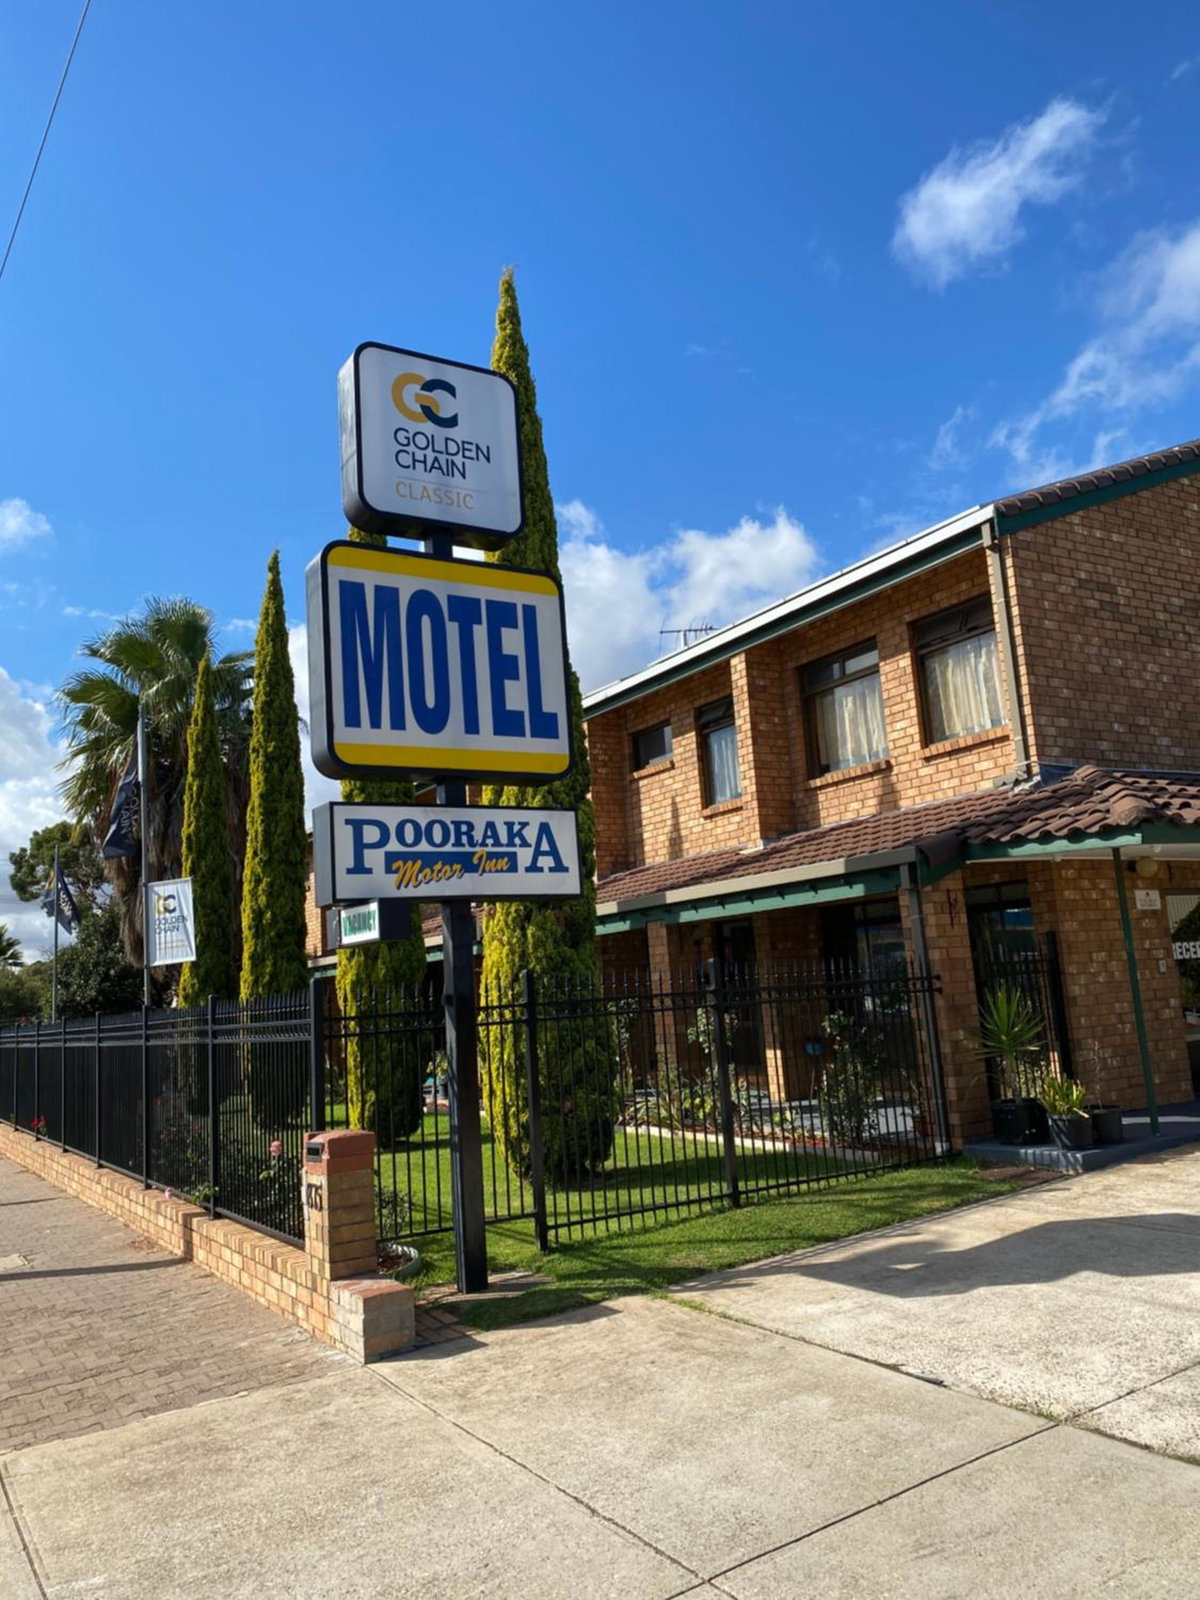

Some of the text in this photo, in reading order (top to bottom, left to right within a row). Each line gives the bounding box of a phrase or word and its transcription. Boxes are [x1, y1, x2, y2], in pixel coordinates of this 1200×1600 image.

[393, 427, 491, 464] GOLDEN
[395, 449, 467, 480] CHAIN
[395, 481, 474, 510] CLASSIC
[338, 579, 560, 740] MOTEL
[344, 818, 569, 876] POORAKA
[392, 849, 511, 890] Motor Inn
